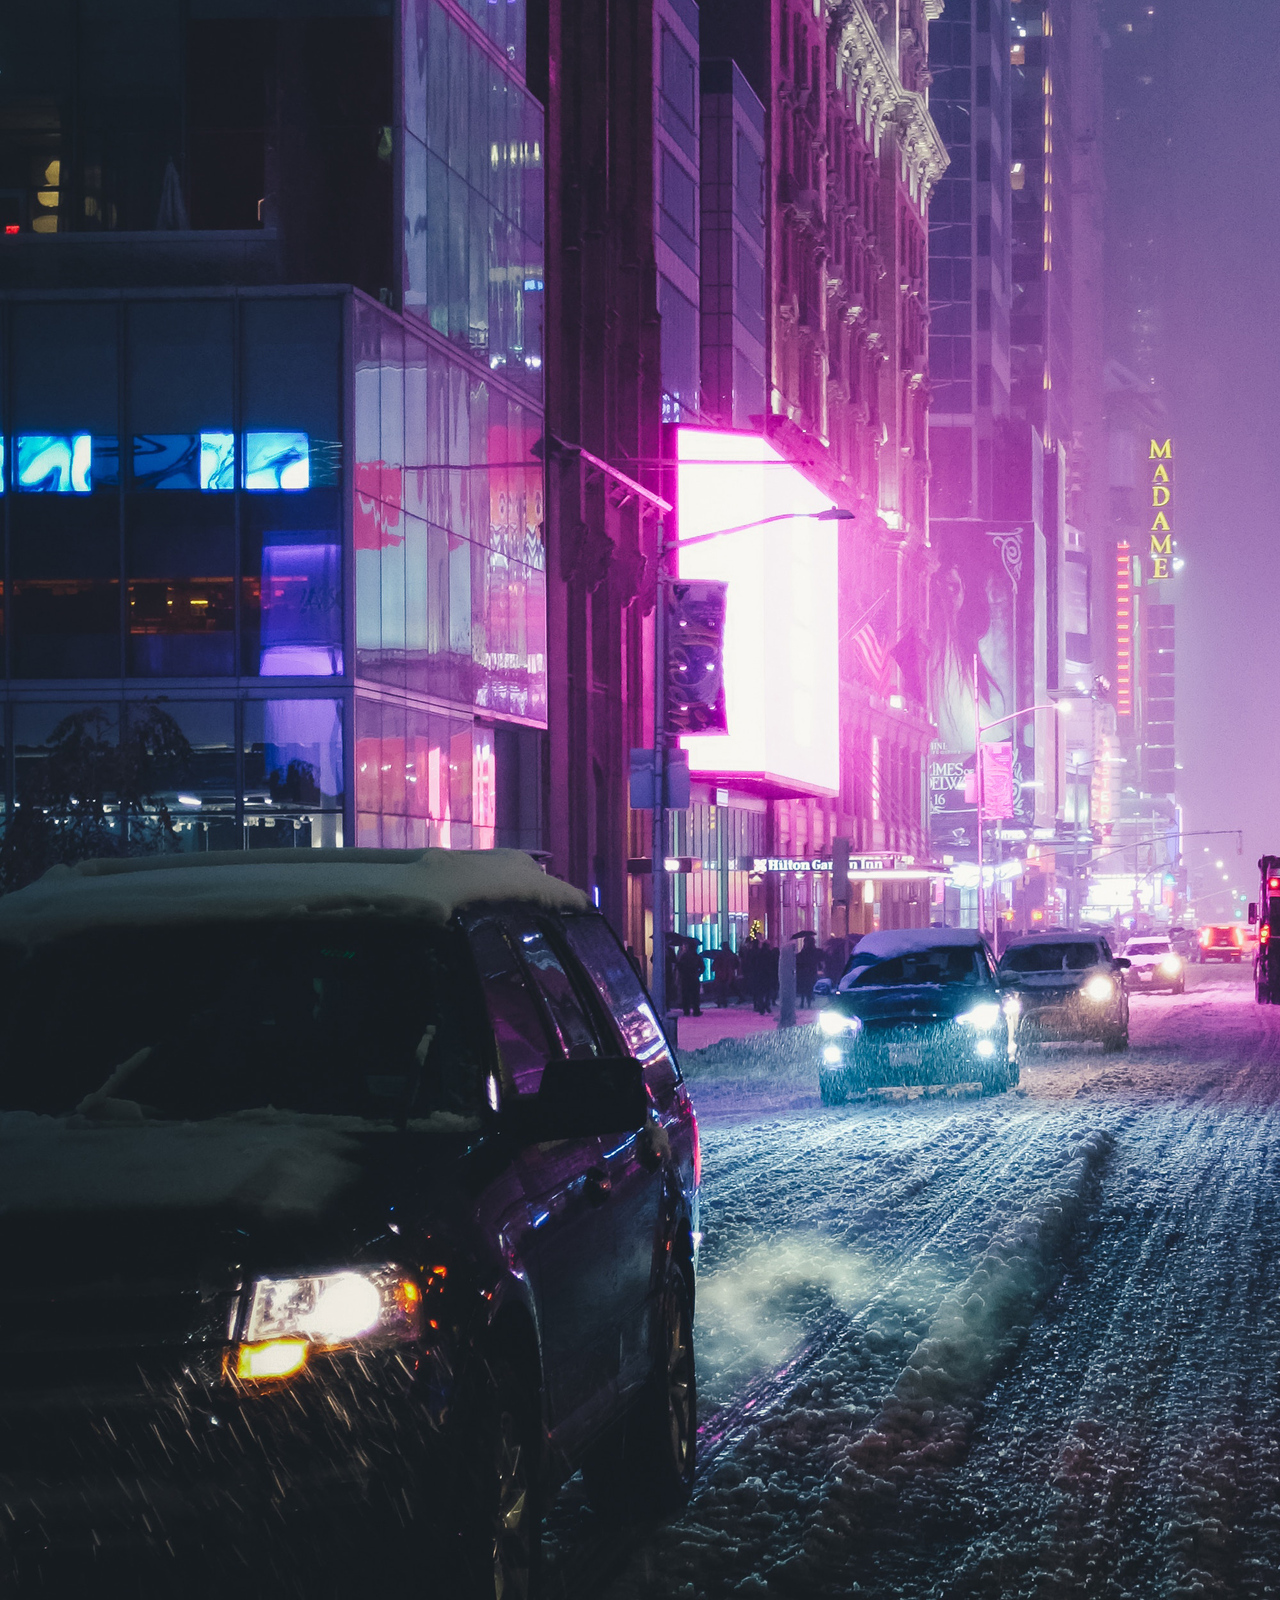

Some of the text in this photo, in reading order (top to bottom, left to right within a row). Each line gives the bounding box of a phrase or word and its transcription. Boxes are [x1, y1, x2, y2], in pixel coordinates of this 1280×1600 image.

[1148, 438, 1172, 579] MADAME
[934, 794, 946, 805] 16
[768, 858, 810, 871] Hilton
[860, 859, 883, 870] Inn
